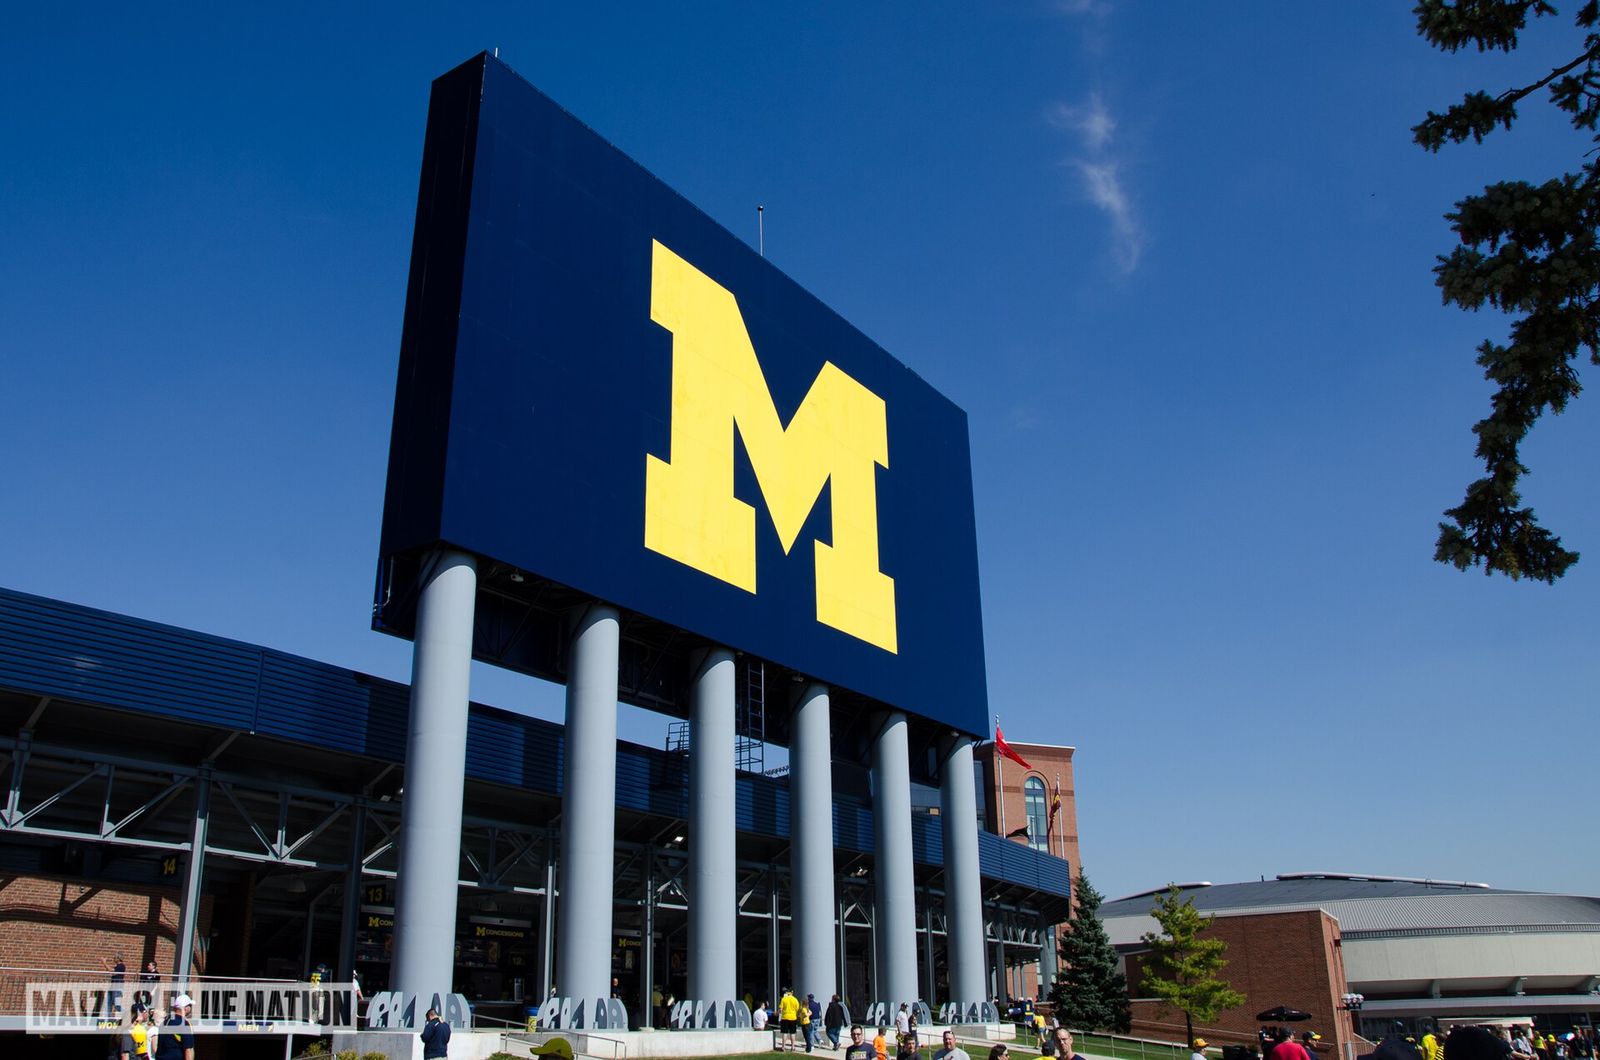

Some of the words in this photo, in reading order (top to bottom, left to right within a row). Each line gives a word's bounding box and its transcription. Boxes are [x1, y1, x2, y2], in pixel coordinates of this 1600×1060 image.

[645, 238, 897, 654] M
[164, 858, 176, 875] 14
[368, 887, 383, 902] 13
[368, 916, 380, 927] M
[476, 926, 486, 937] M
[486, 928, 524, 938] CONCESSIONS
